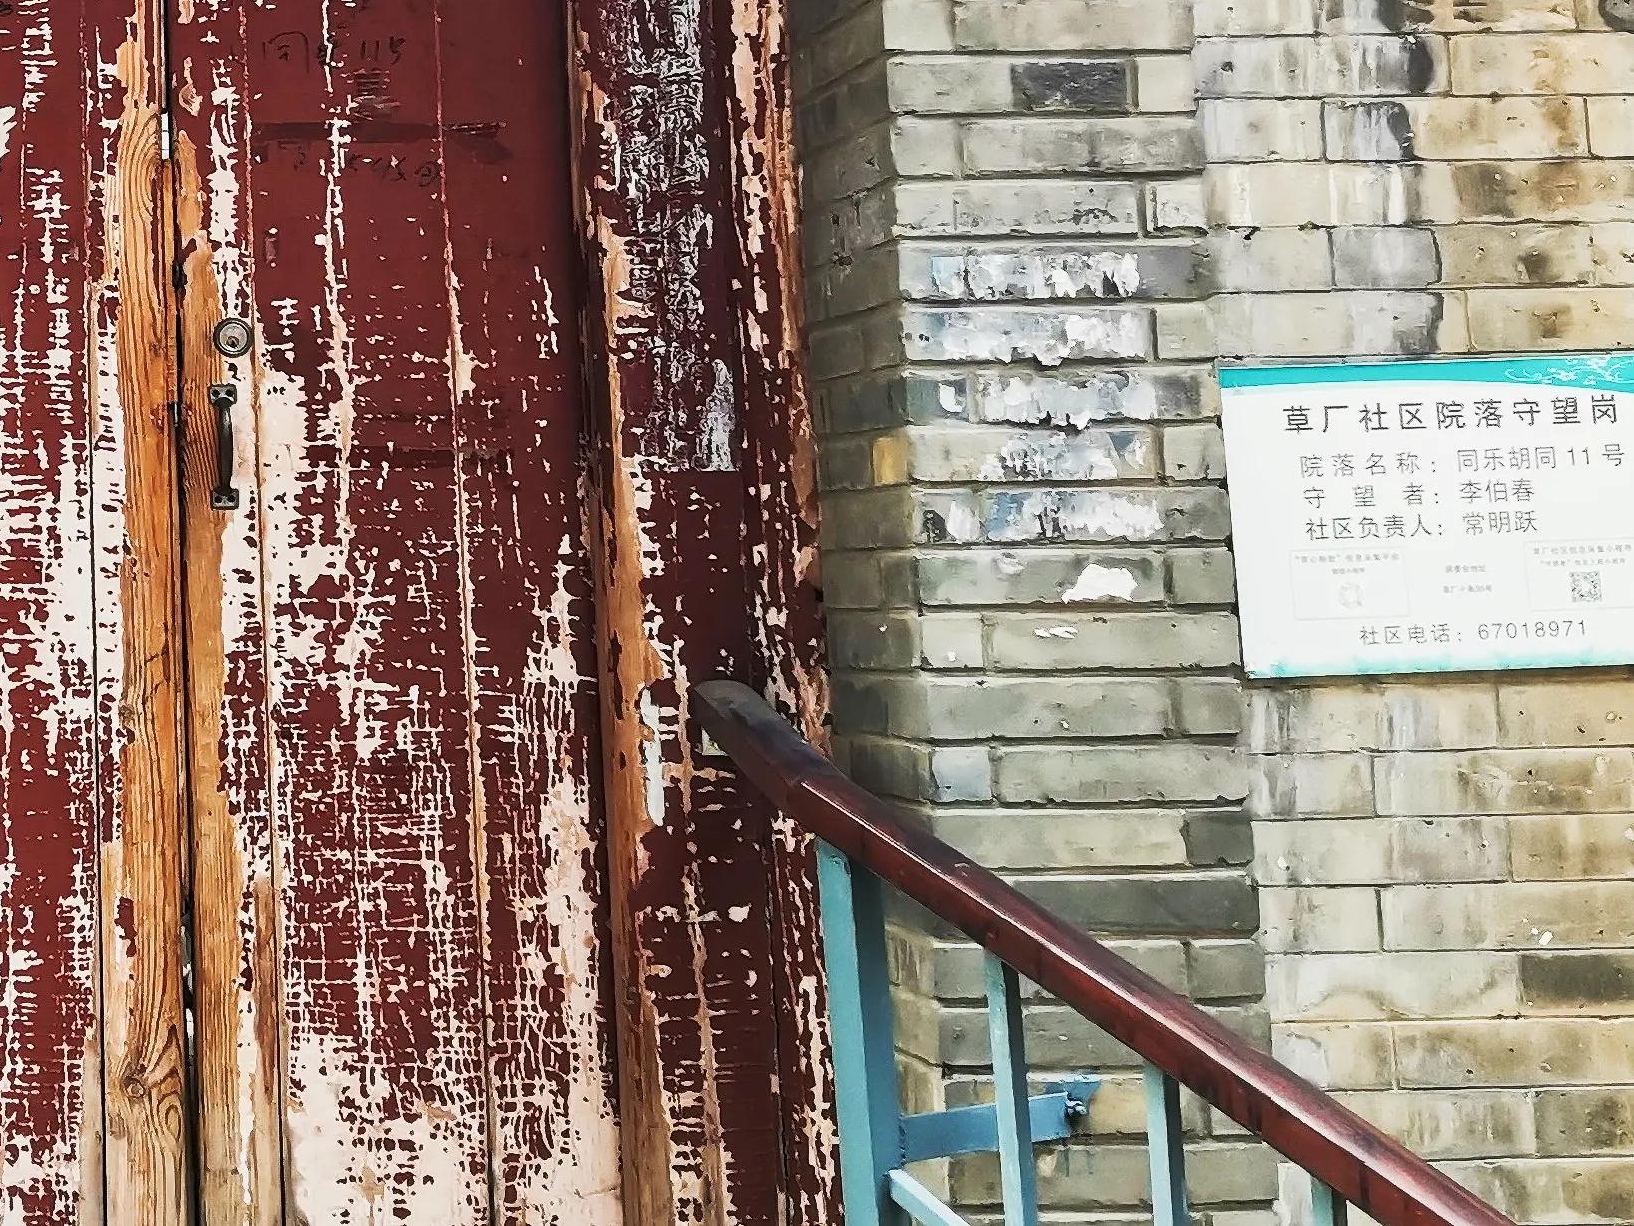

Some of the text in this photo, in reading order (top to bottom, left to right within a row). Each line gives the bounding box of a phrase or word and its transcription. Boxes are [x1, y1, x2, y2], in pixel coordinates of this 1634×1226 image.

[1283, 394, 1618, 434] 草厂社区院落守望岗
